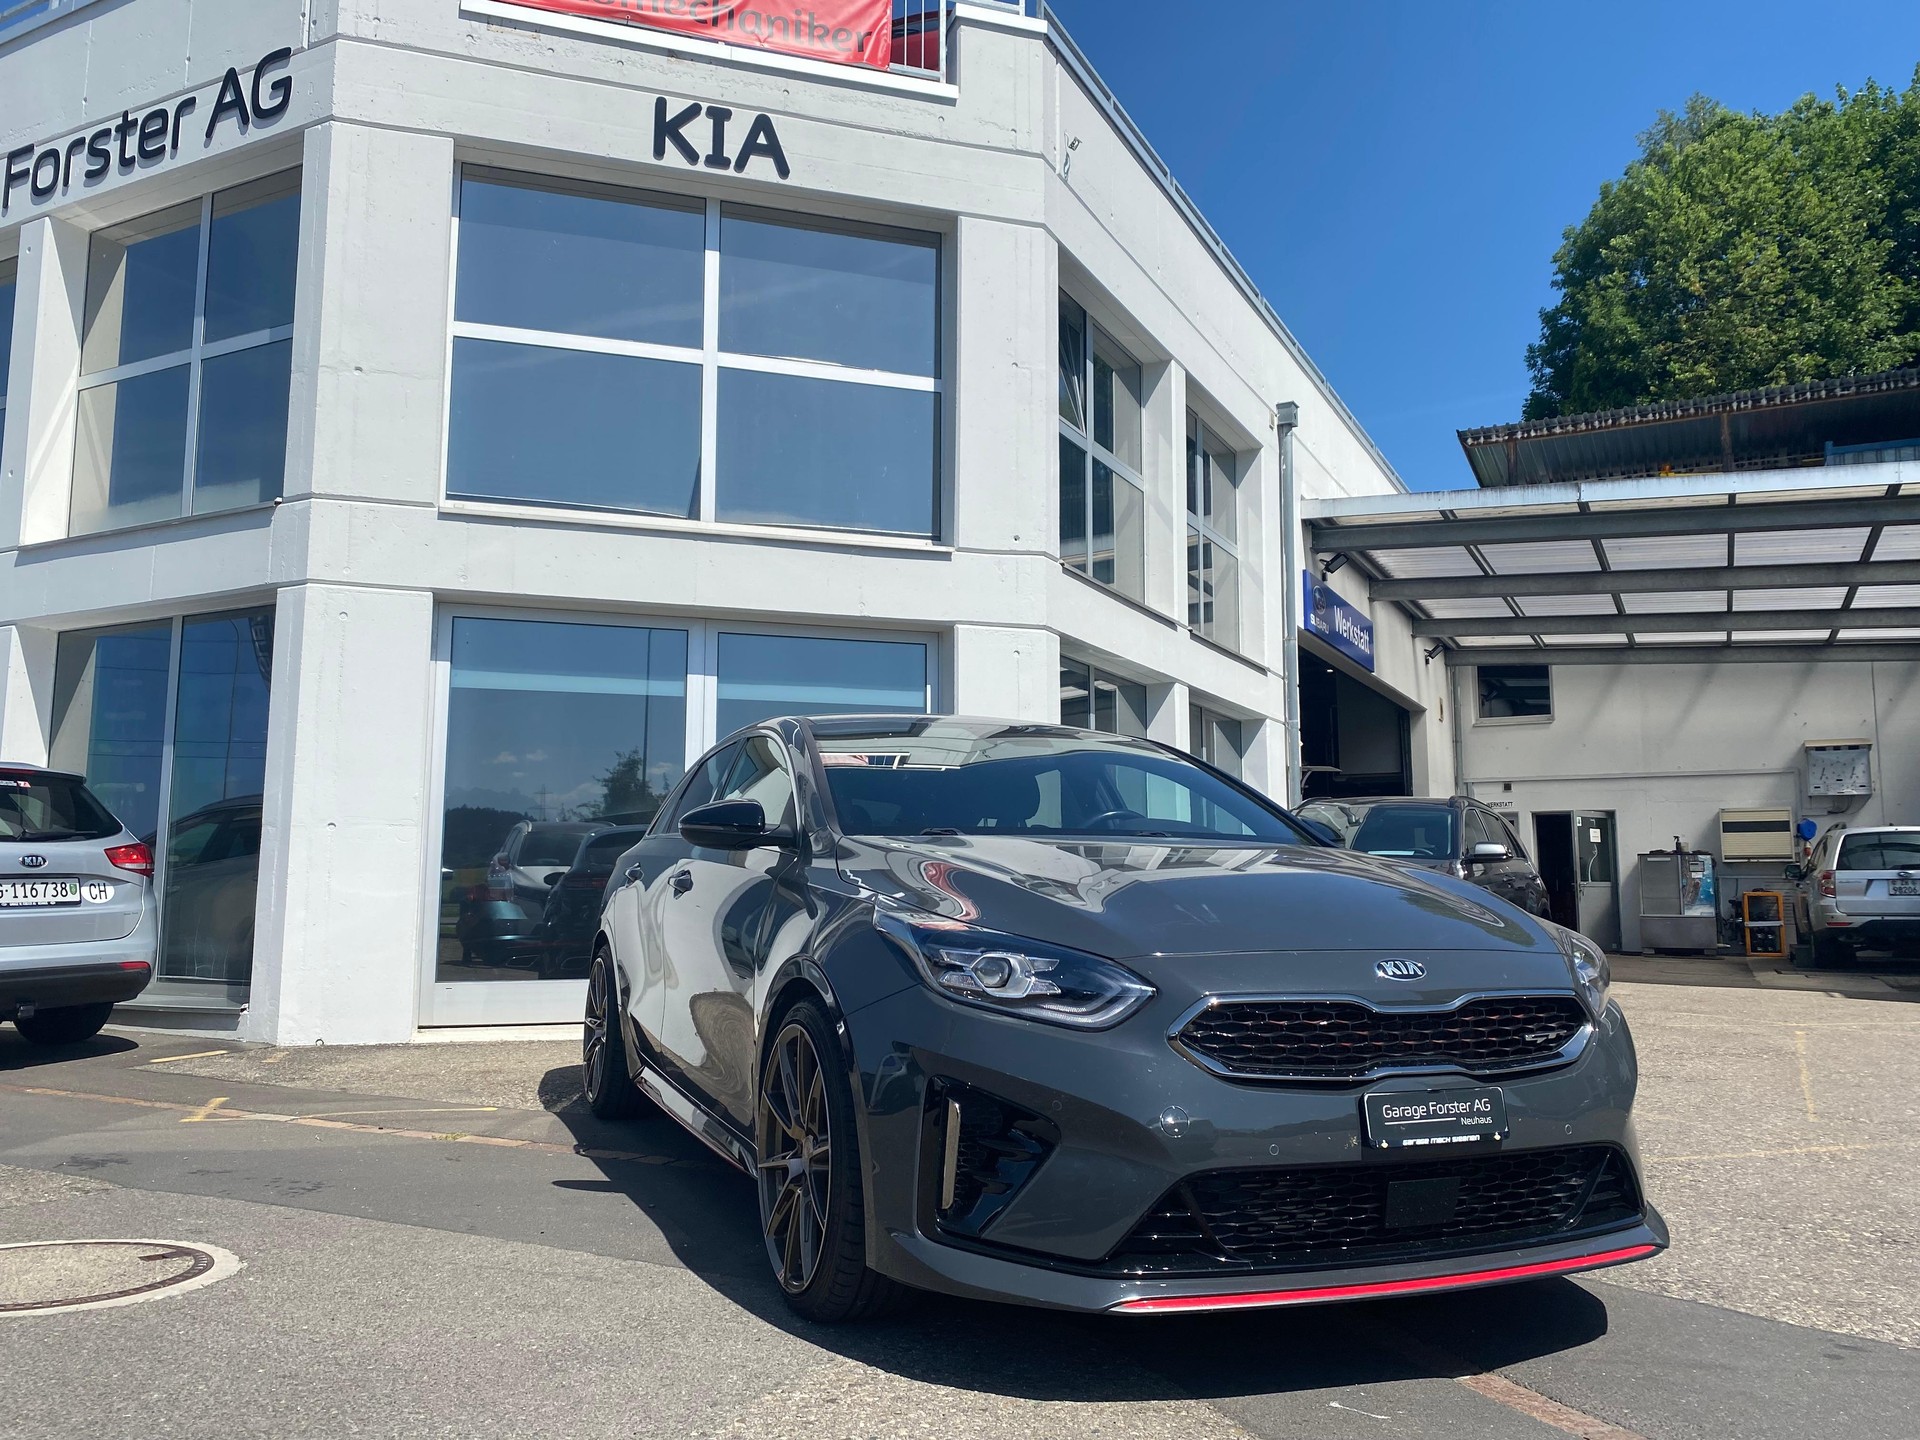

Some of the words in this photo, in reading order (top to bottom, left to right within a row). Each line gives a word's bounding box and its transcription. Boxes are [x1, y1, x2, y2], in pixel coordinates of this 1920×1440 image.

[1, 96, 197, 210] Forster
[205, 46, 293, 139] AG
[653, 96, 791, 179] KIA
[1333, 605, 1370, 655] Werkstatt
[24, 856, 44, 866] KIA
[88, 882, 108, 900] CH
[1380, 961, 1423, 976] KIA
[1382, 1104, 1427, 1119] Garage
[1429, 1100, 1471, 1115] Forster
[1474, 1098, 1491, 1111] AG
[1461, 1115, 1493, 1126] Neuhaus
